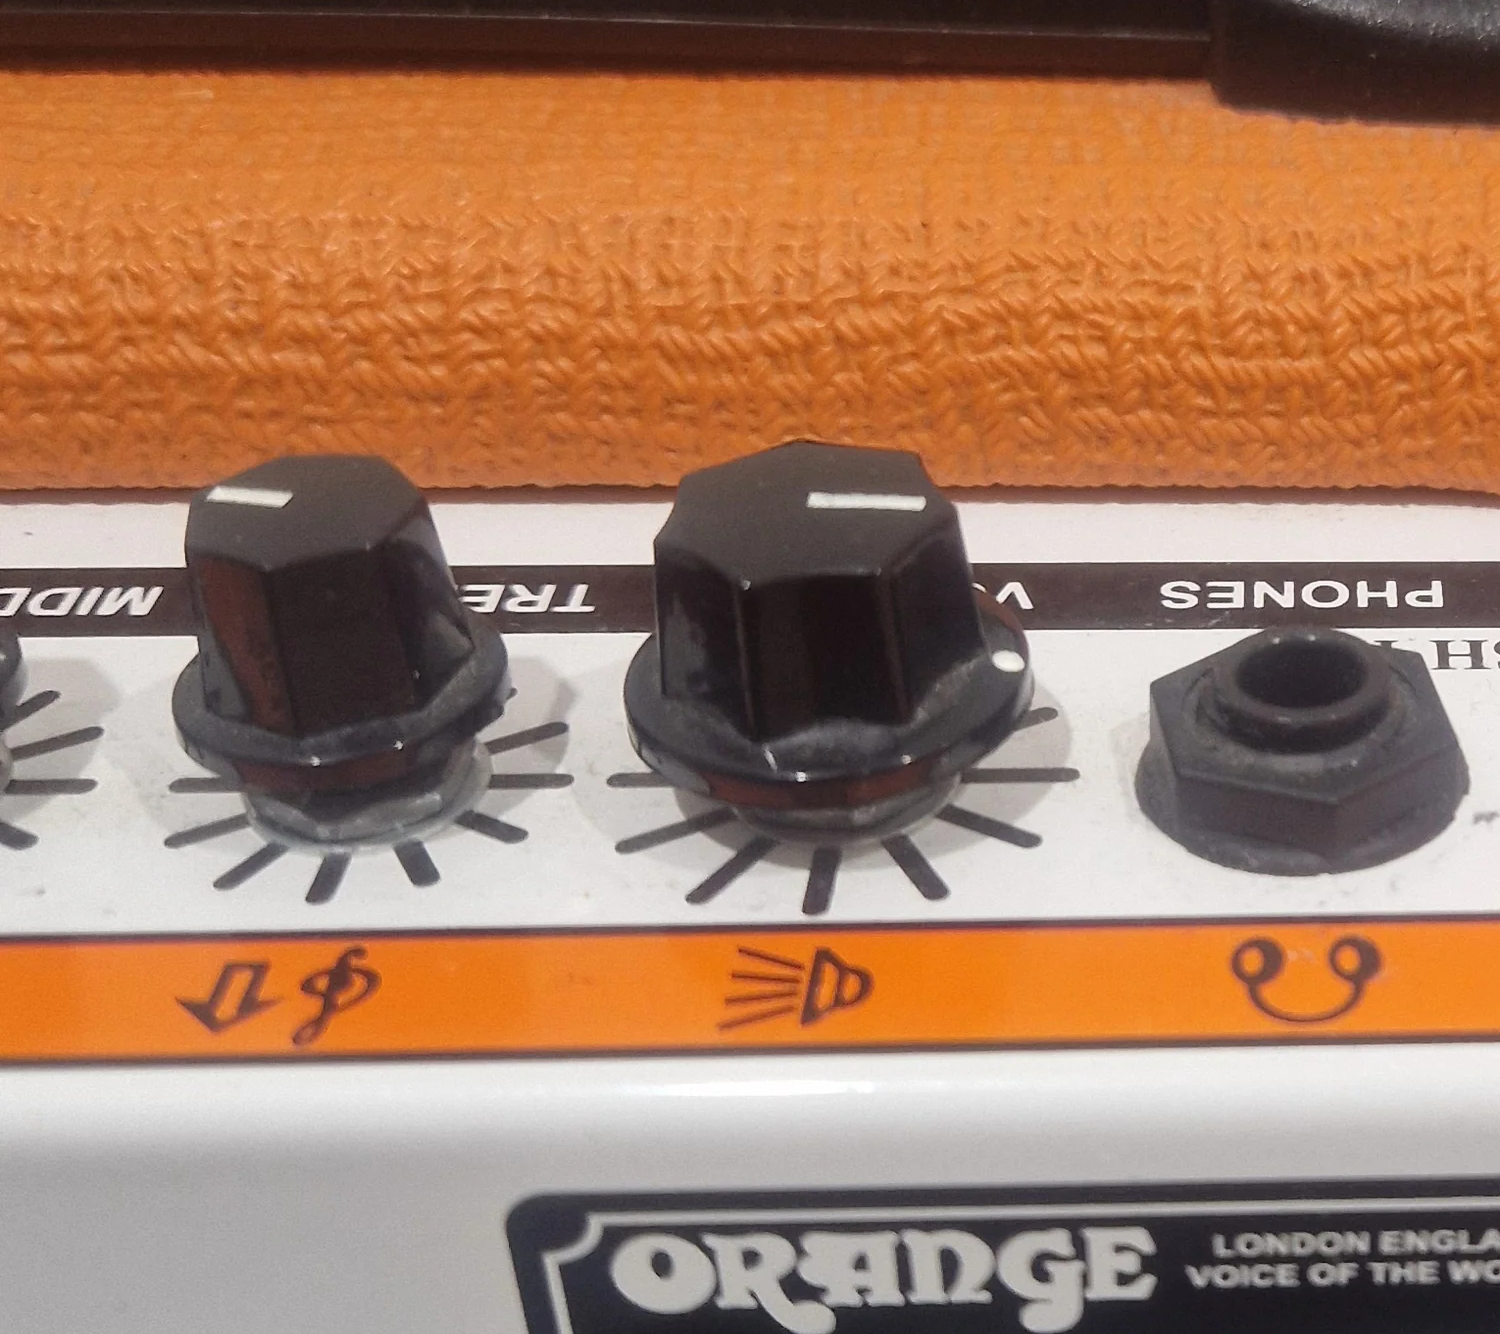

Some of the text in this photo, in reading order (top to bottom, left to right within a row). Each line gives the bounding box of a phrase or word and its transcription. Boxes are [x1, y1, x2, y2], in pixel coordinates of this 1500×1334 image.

[1159, 580, 1444, 609] PHONES
[1212, 1231, 1371, 1258] LONDON
[1185, 1263, 1300, 1289] VOICE
[1306, 1262, 1359, 1287] OF
[1367, 1260, 1440, 1285] THE
